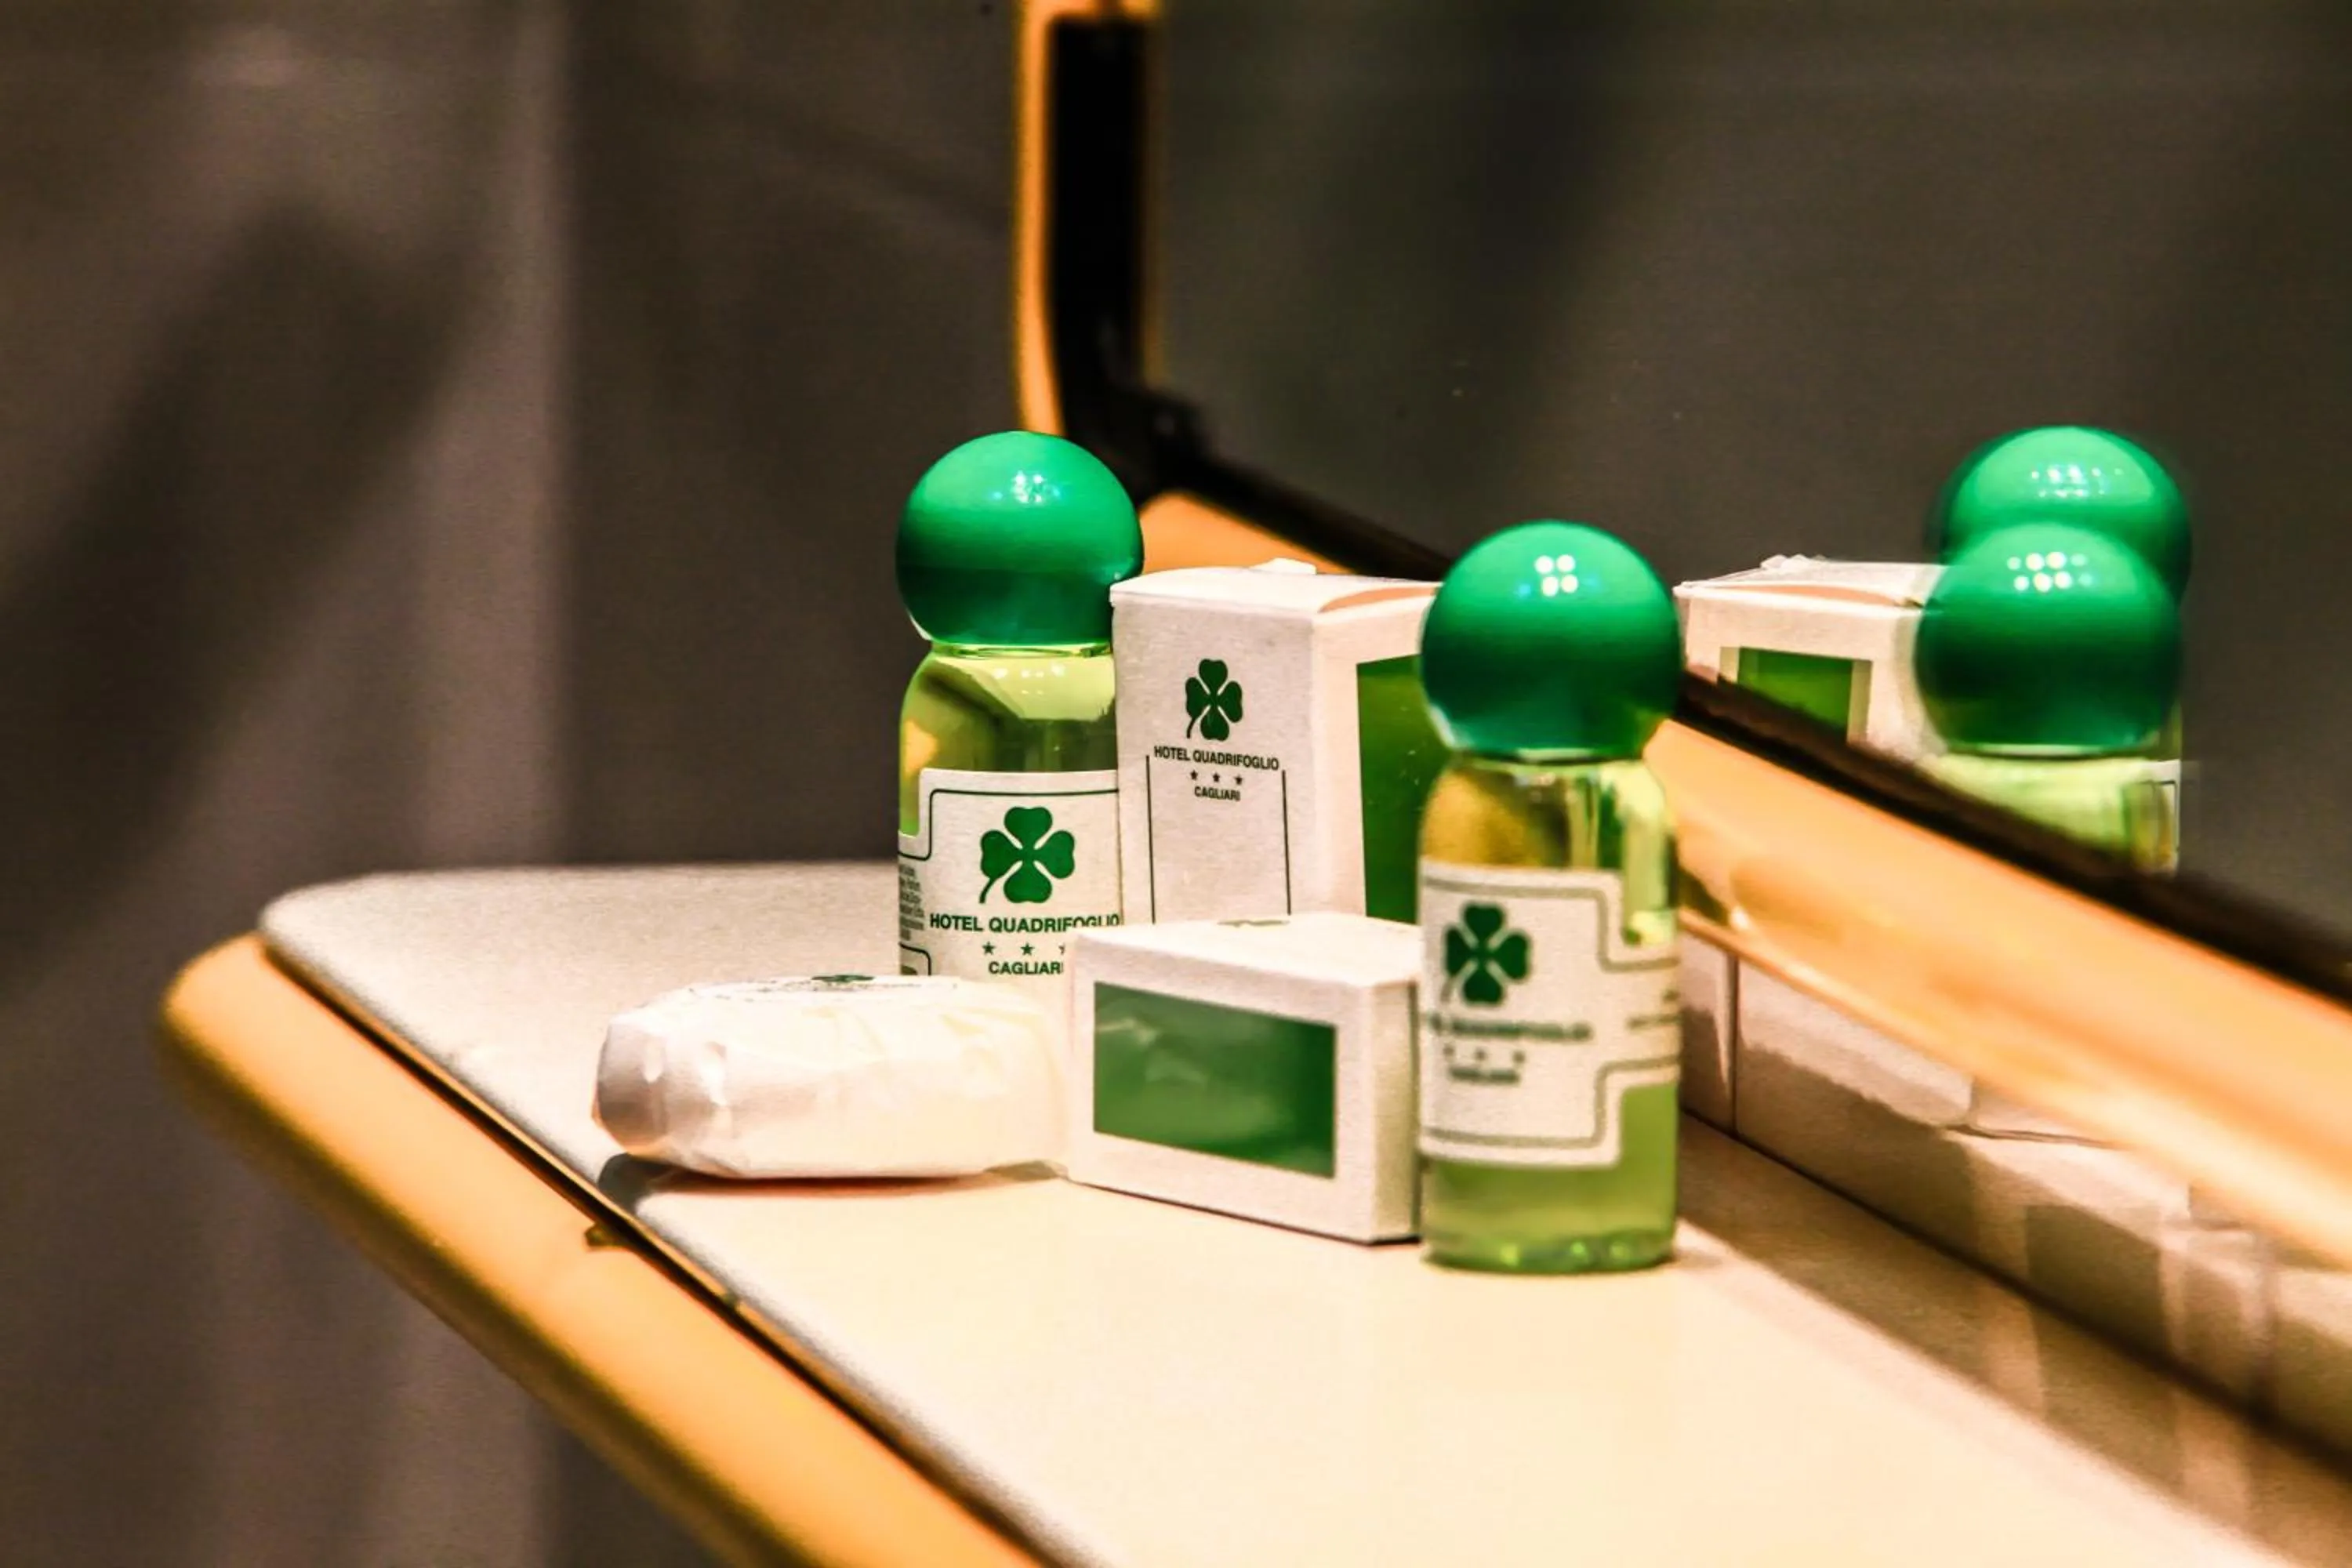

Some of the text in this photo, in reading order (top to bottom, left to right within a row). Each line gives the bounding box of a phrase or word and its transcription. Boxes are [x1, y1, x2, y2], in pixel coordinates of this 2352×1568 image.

[1154, 746, 1279, 771] HOTEL QUADRIFOGLIO
[1194, 786, 1241, 801] CAGLIARI
[930, 913, 984, 932] HOTEL
